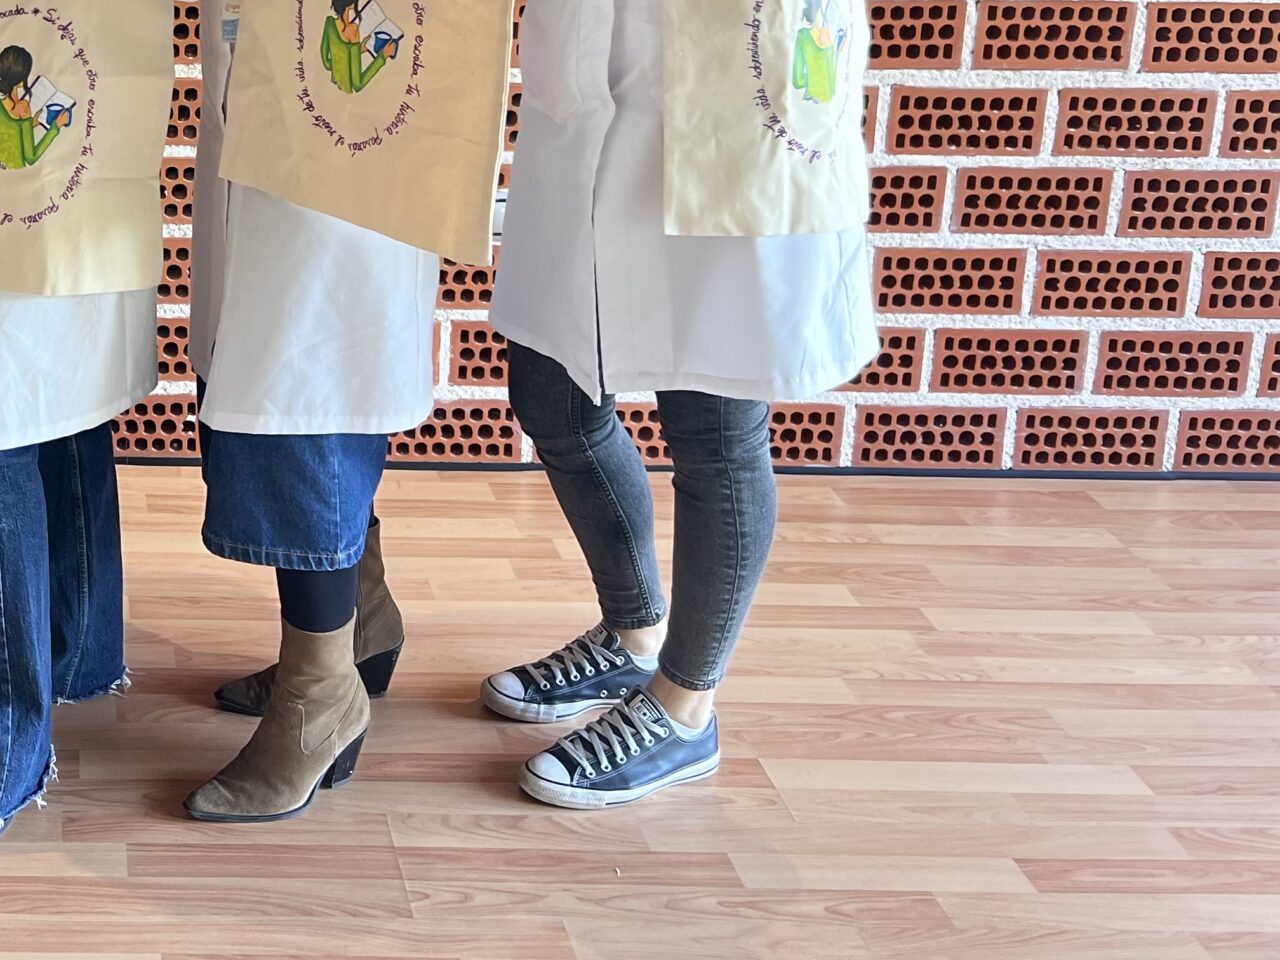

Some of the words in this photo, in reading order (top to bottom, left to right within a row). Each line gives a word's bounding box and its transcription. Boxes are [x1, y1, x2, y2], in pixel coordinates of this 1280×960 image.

[43, 8, 59, 25] Si
[73, 48, 90, 67] que
[409, 35, 425, 79] escriba
[295, 60, 305, 82] vida
[303, 100, 315, 113] de
[752, 84, 771, 110] vida
[82, 98, 96, 141] escriba
[335, 134, 344, 147] el
[0, 212, 13, 225] el
